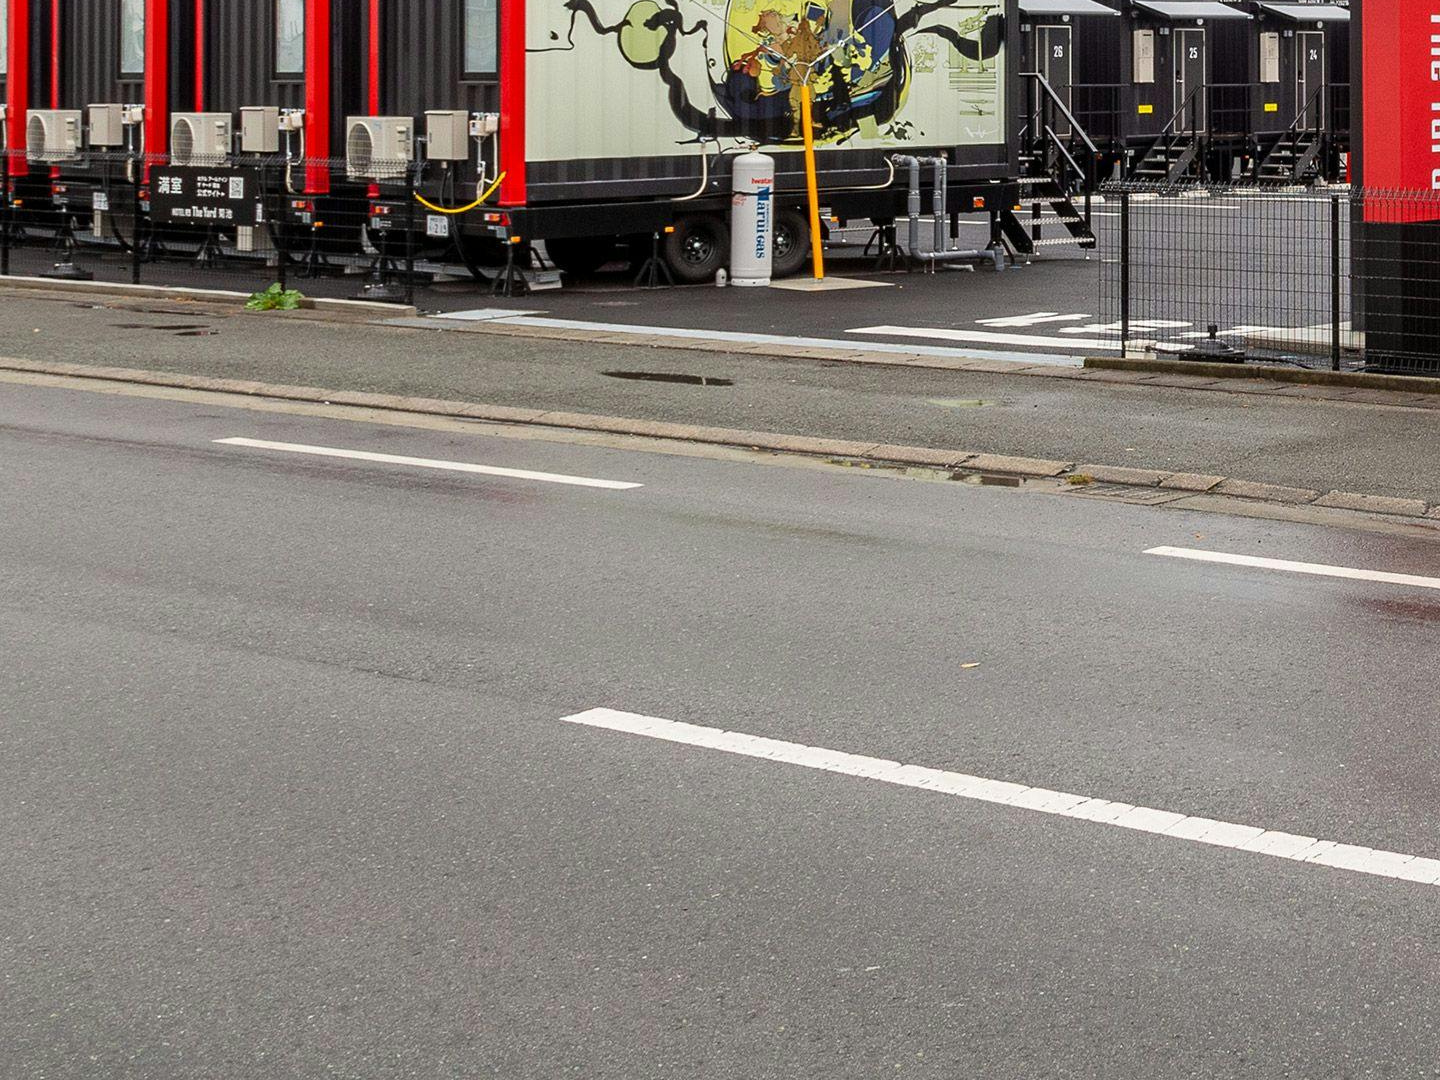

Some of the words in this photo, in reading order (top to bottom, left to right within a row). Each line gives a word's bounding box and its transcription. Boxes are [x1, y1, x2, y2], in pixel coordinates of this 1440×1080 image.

[1053, 45, 1064, 58] 26
[1189, 47, 1198, 59] 25
[1309, 49, 1318, 60] 24
